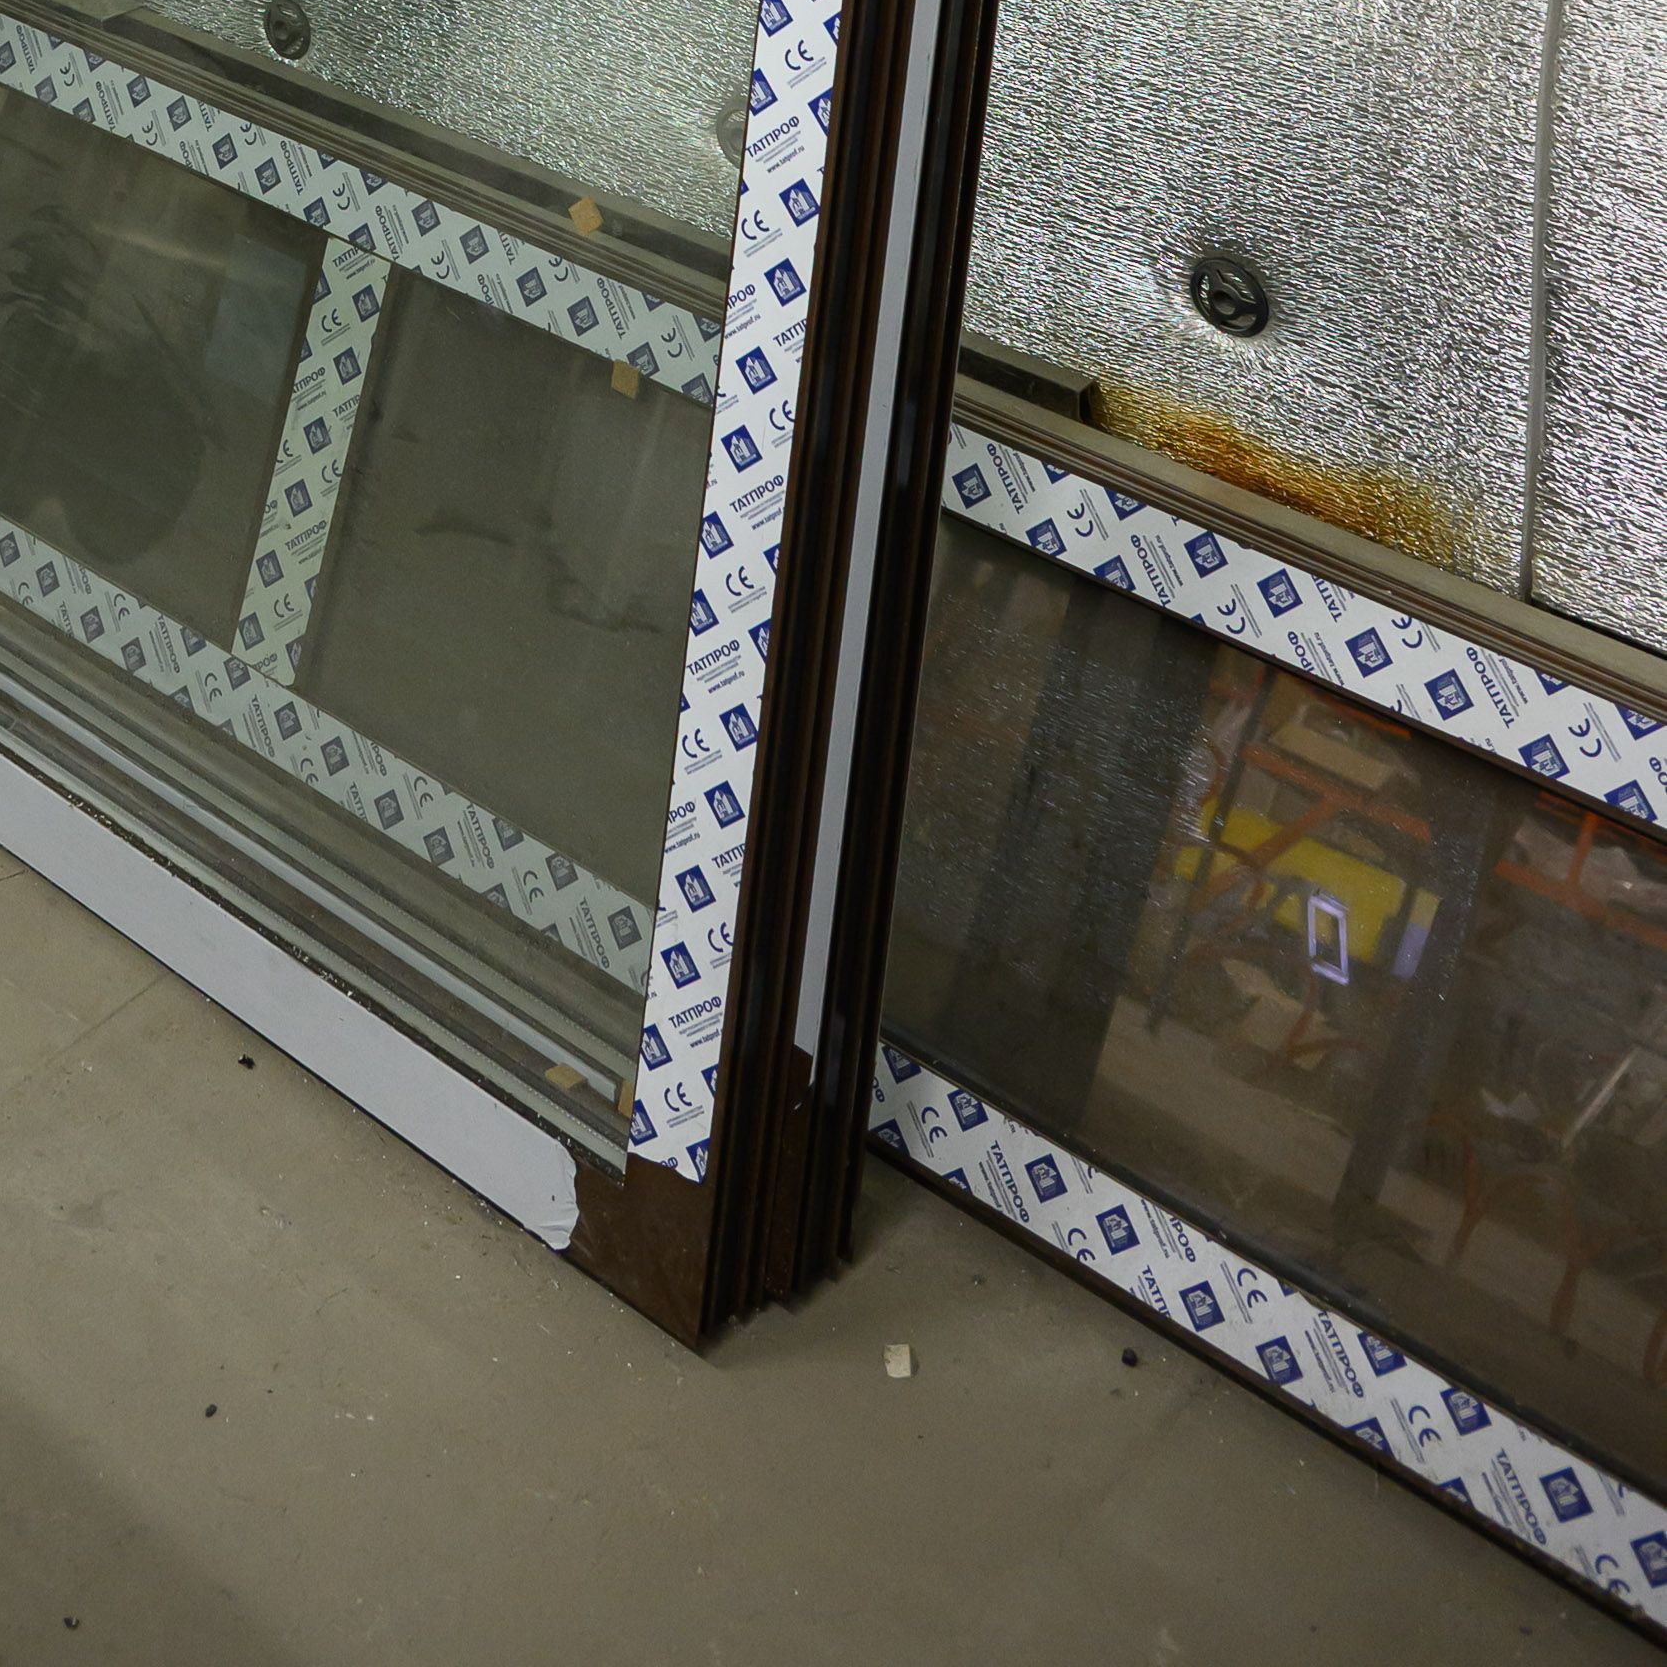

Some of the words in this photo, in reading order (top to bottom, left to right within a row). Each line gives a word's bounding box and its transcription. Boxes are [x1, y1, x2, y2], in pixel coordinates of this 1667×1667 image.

[746, 116, 800, 159] ТАТПРОФ
[730, 475, 784, 513] ТАТПРОФ
[987, 443, 1025, 515] ТАТПРОФ
[1130, 534, 1172, 607] ТАТПРОФ
[687, 640, 740, 675] ТАТПРОФ
[1466, 646, 1515, 729] ТАТПРОФ
[668, 996, 721, 1028] ТАТПРОФ
[989, 1140, 1030, 1223] ТАТПРОФ
[1317, 1310, 1364, 1398] ТАТПРОФ
[1496, 1447, 1547, 1546] ТАТПРОФ
